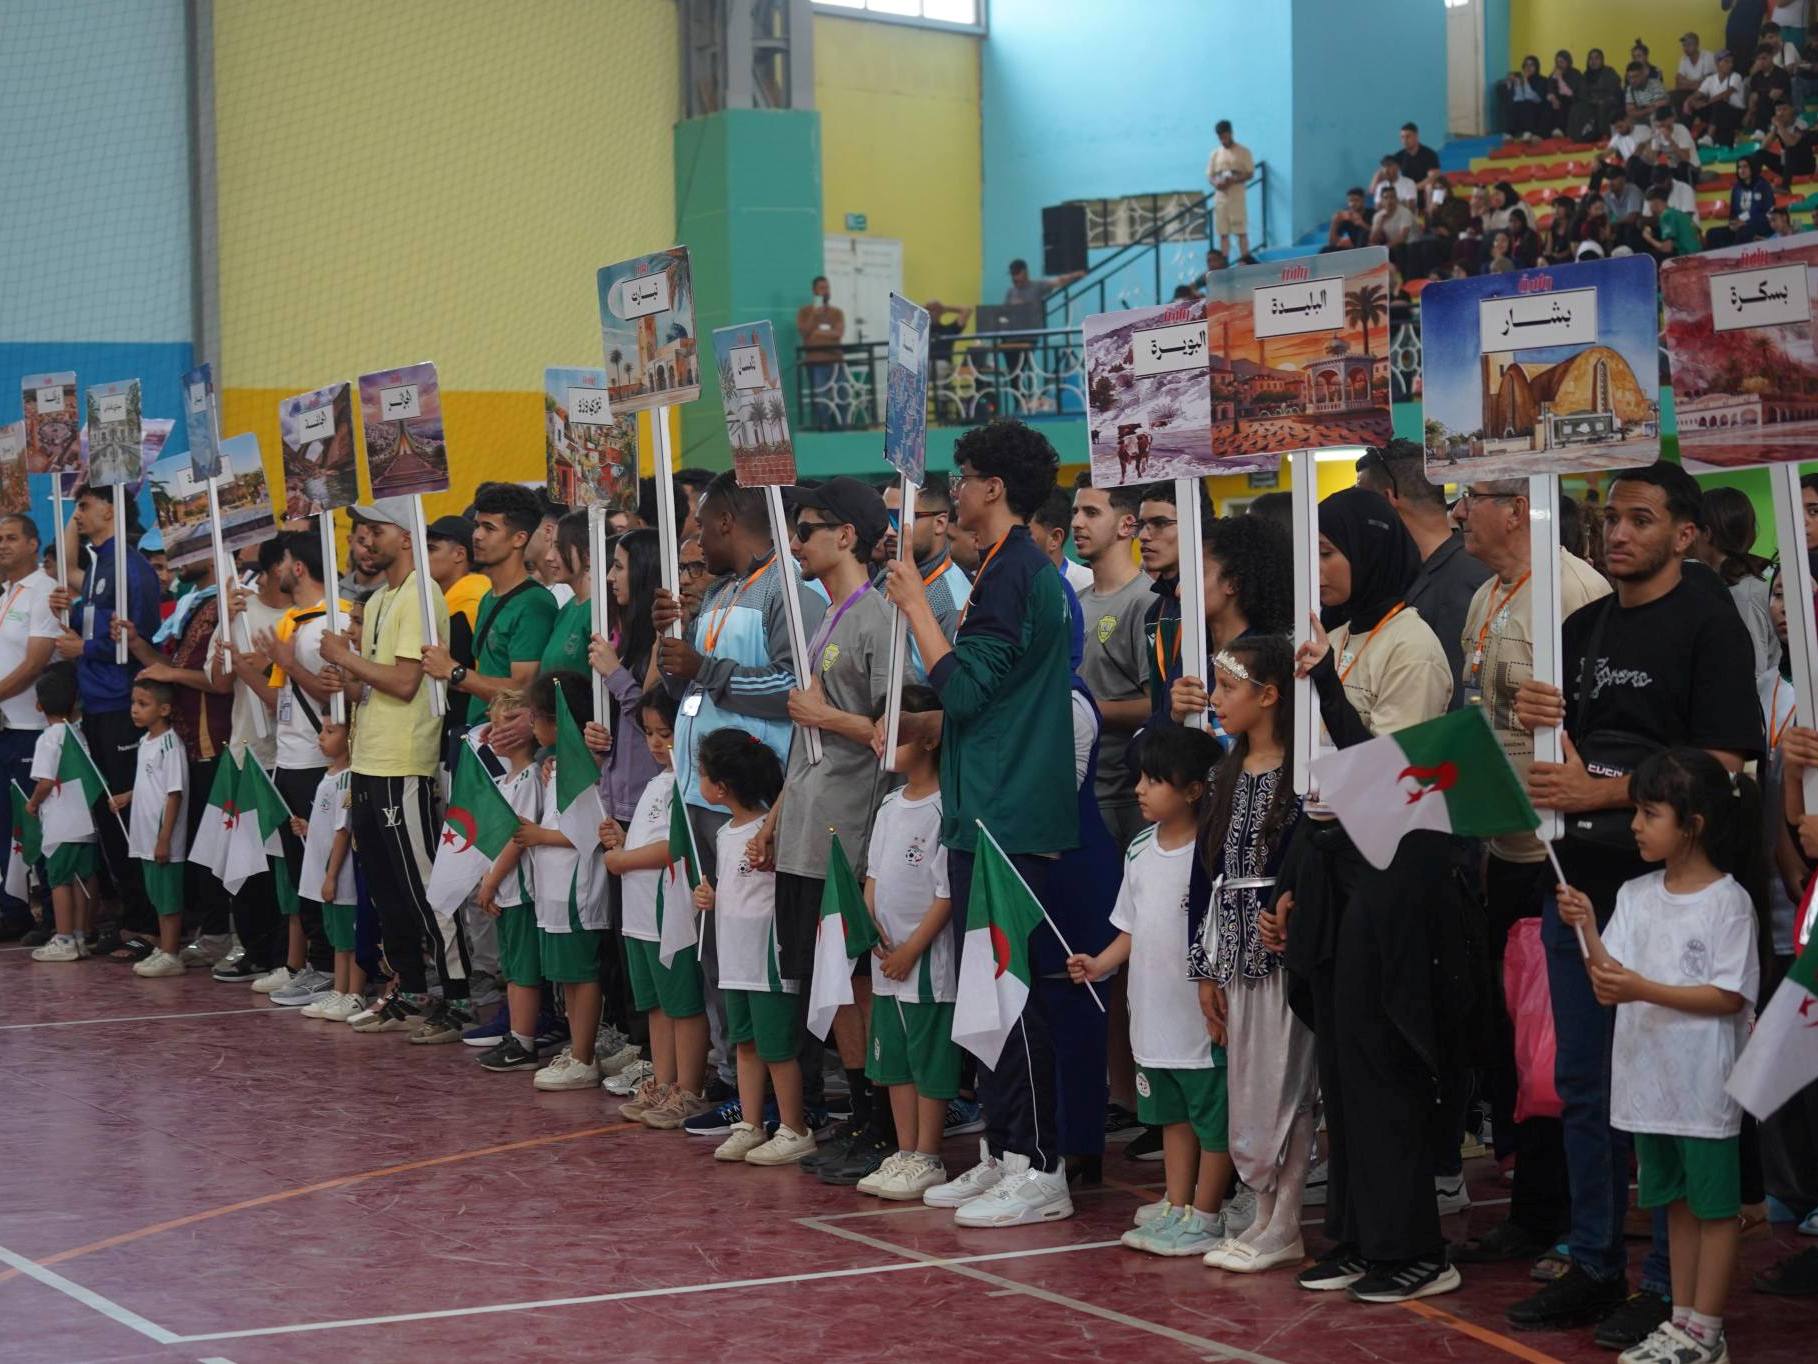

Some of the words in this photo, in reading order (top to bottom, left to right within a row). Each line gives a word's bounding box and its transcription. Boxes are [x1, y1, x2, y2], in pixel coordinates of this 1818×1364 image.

[1271, 288, 1327, 316] البليدة
[1729, 279, 1788, 312] بسكرة
[1501, 301, 1572, 336] بشار
[1151, 329, 1206, 361] البويرة
